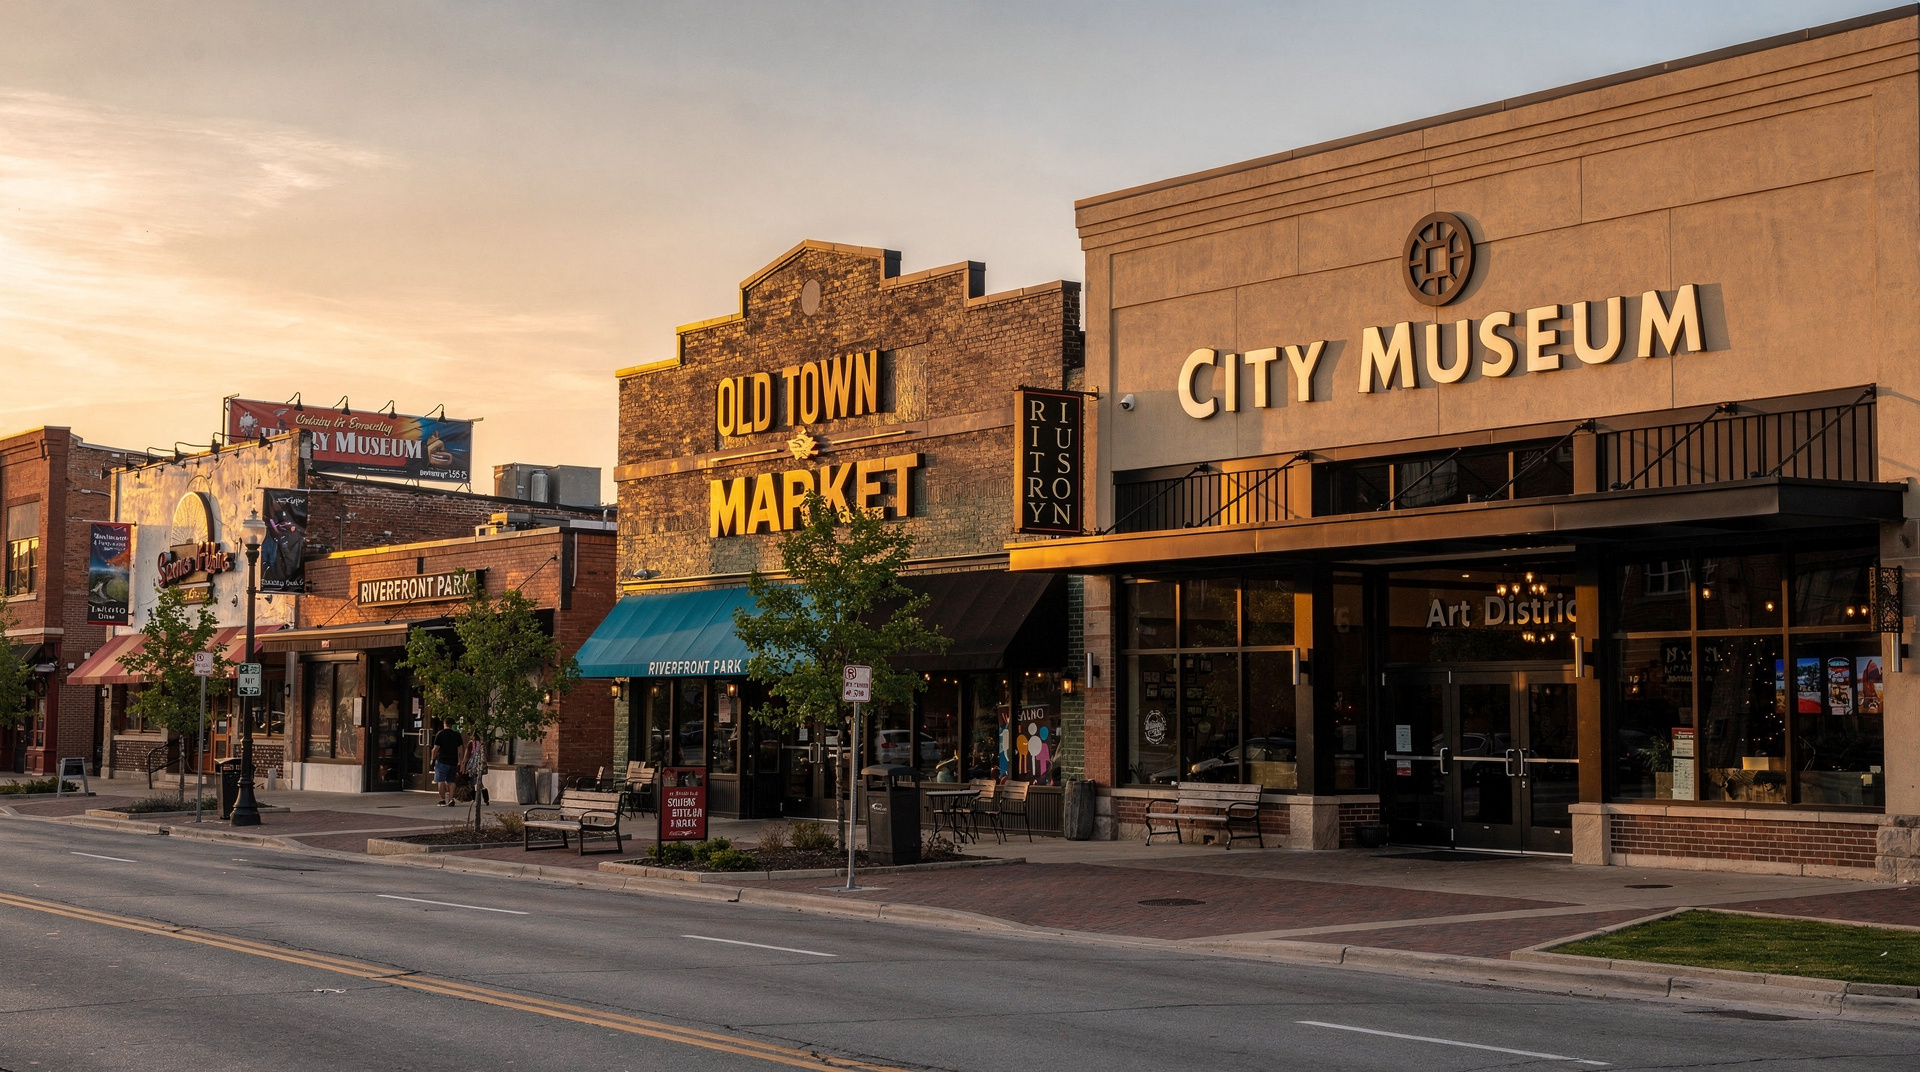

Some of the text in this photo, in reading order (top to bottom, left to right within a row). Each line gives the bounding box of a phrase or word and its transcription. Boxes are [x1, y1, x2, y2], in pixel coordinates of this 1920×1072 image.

[1178, 283, 1708, 419] CITY MUSEUM
[717, 349, 880, 437] OLD TOWN
[336, 431, 424, 459] MUSEUM
[709, 453, 919, 538] MARKET
[361, 573, 470, 603] RIVERFRONT PARK
[1426, 598, 1471, 628] Art
[648, 659, 742, 675] RIVERFRONT PARK
